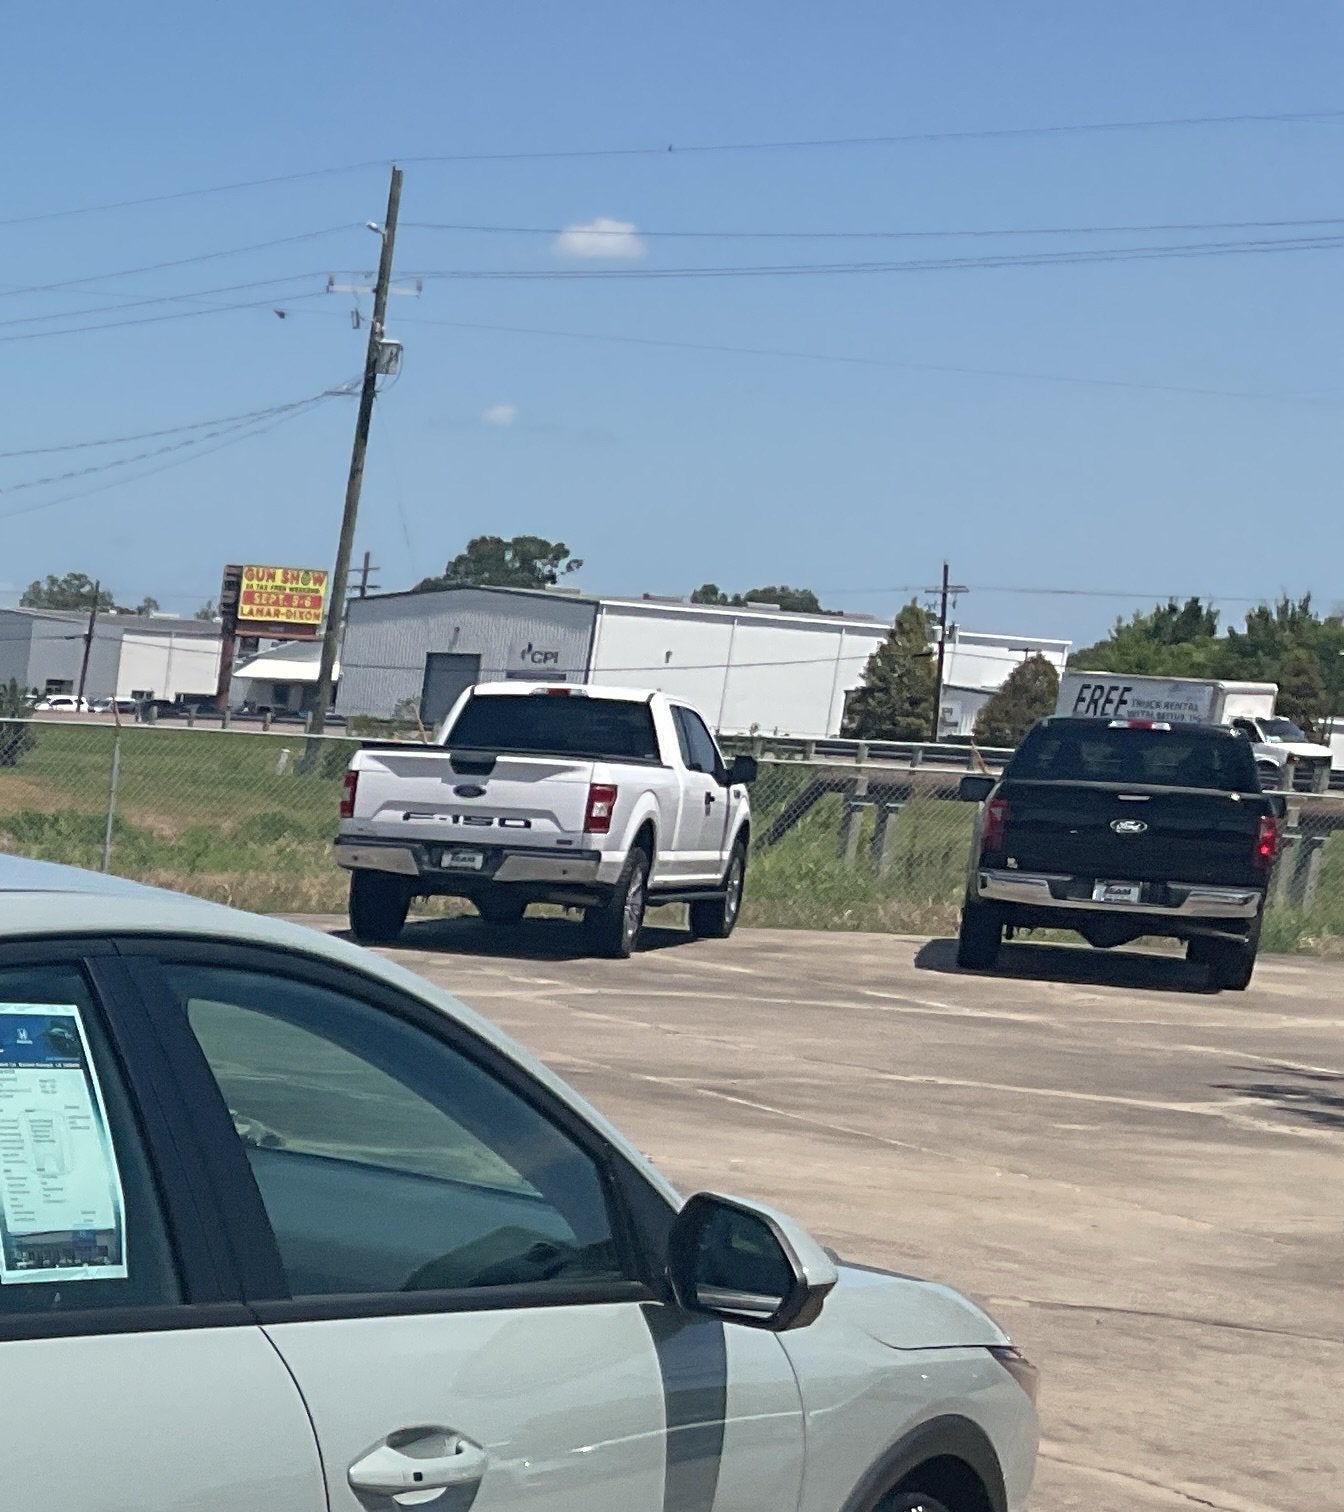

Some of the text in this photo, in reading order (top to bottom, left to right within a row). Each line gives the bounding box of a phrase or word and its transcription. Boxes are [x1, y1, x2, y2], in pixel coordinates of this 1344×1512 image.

[244, 567, 325, 587] GUN SHOW
[1073, 683, 1132, 717] FREE
[402, 811, 531, 829] F-150
